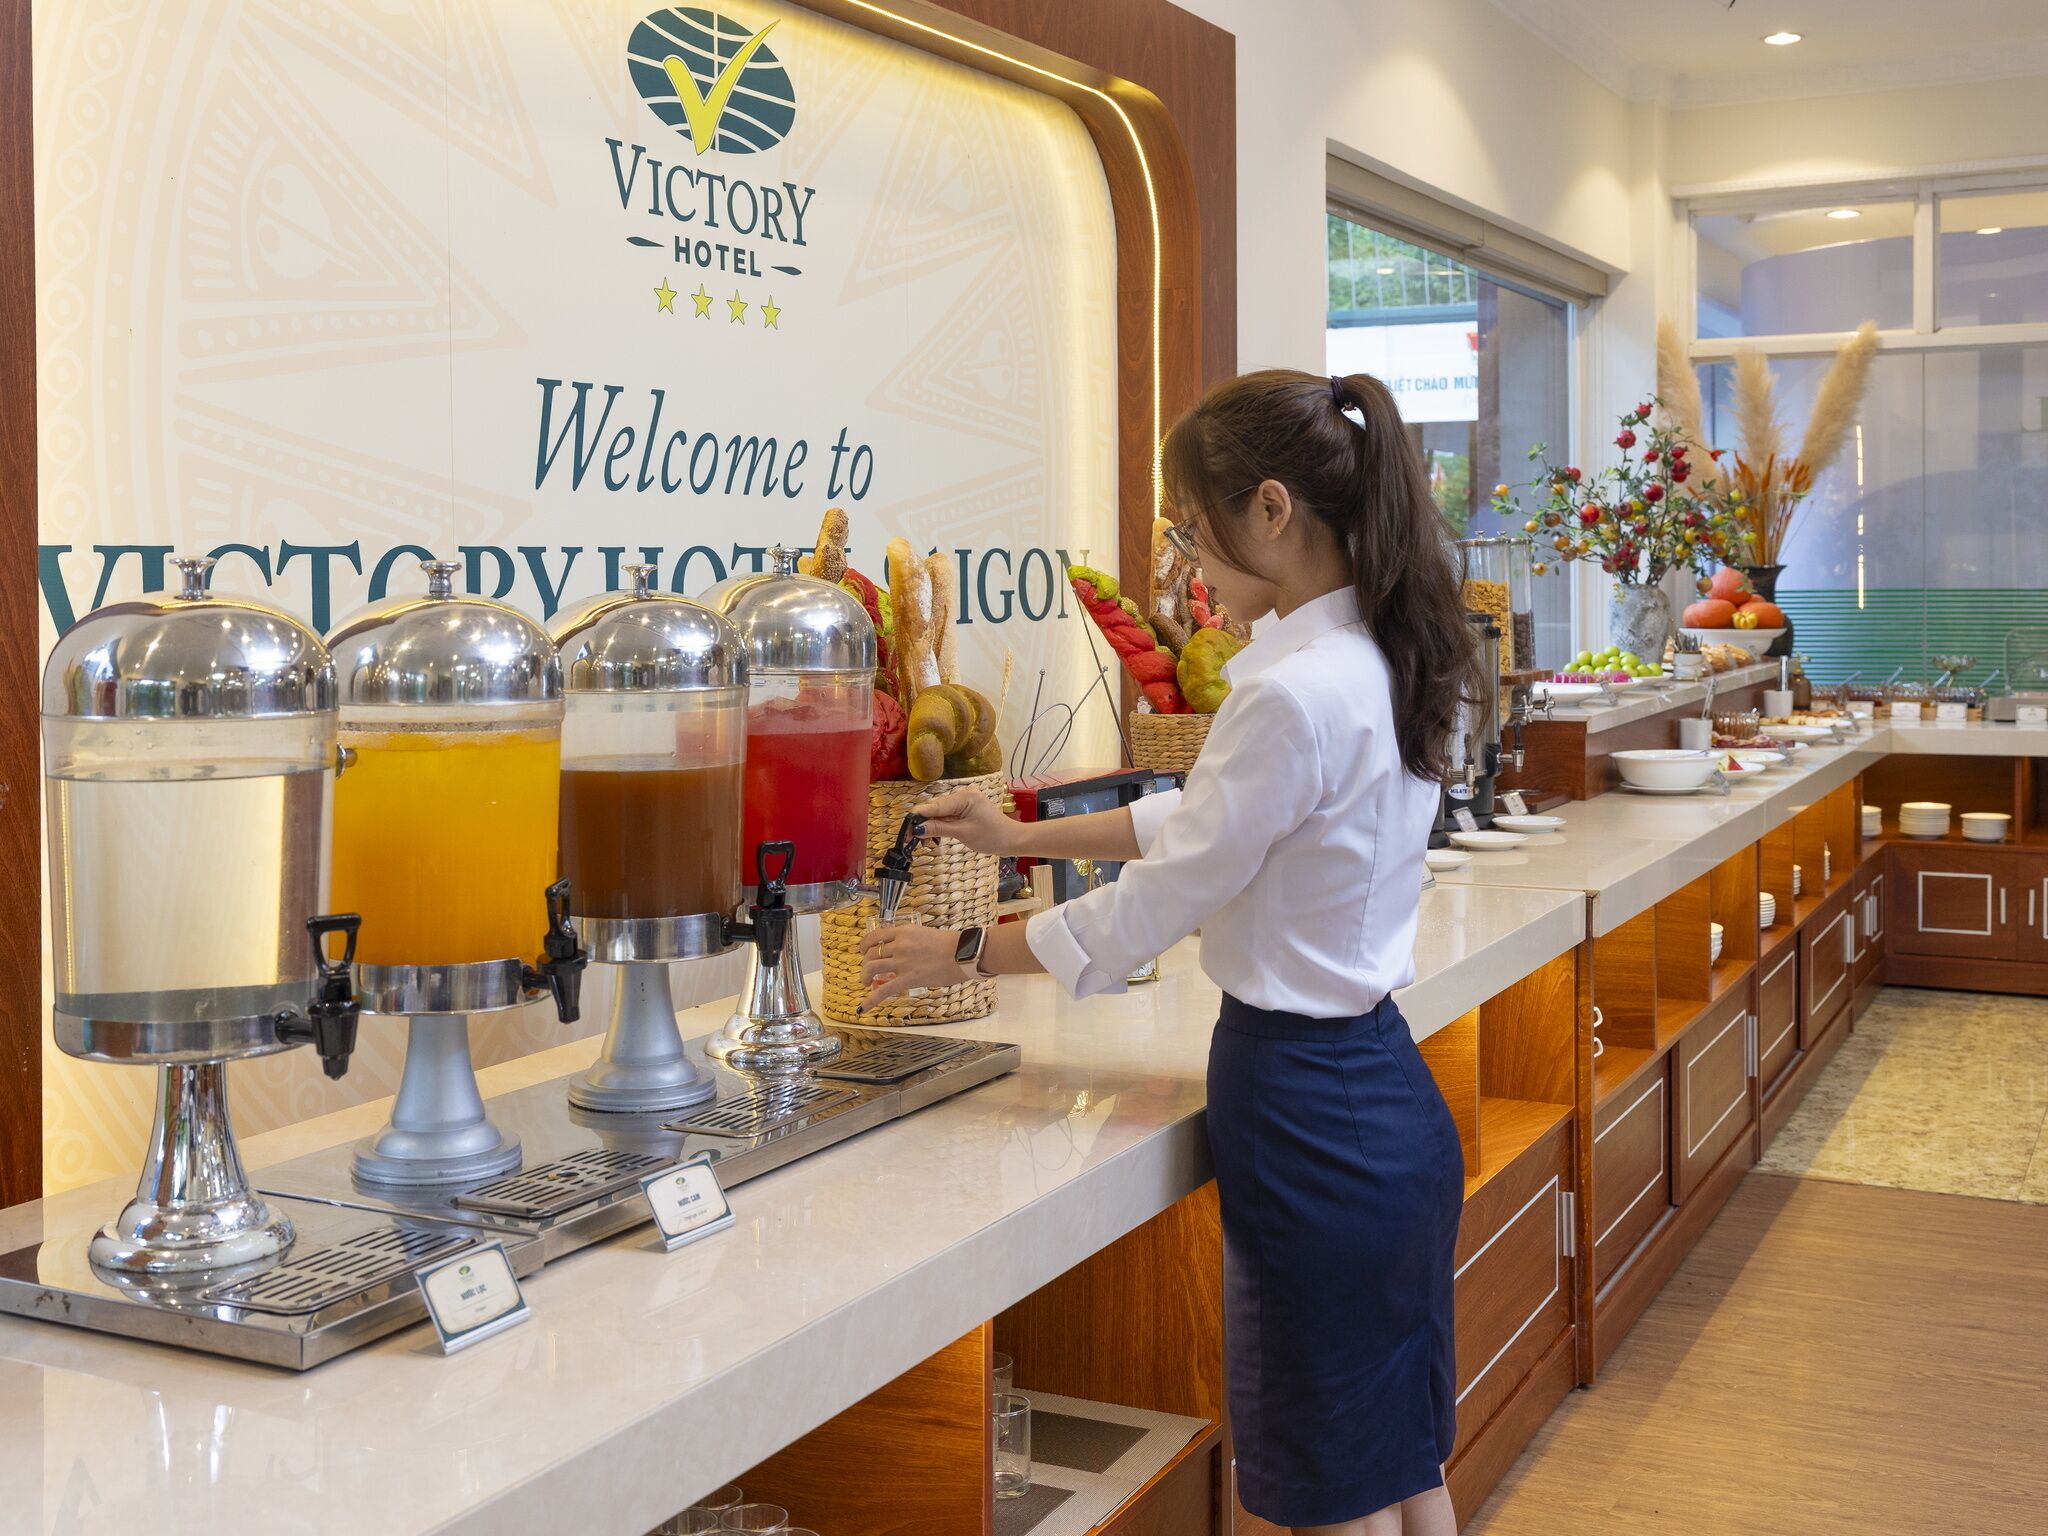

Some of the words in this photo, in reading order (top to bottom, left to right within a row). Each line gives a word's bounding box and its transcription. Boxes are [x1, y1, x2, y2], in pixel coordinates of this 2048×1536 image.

[605, 137, 815, 246] VICTORY
[674, 235, 762, 277] HOTEL
[535, 377, 808, 498] Welcome
[827, 426, 873, 501] to
